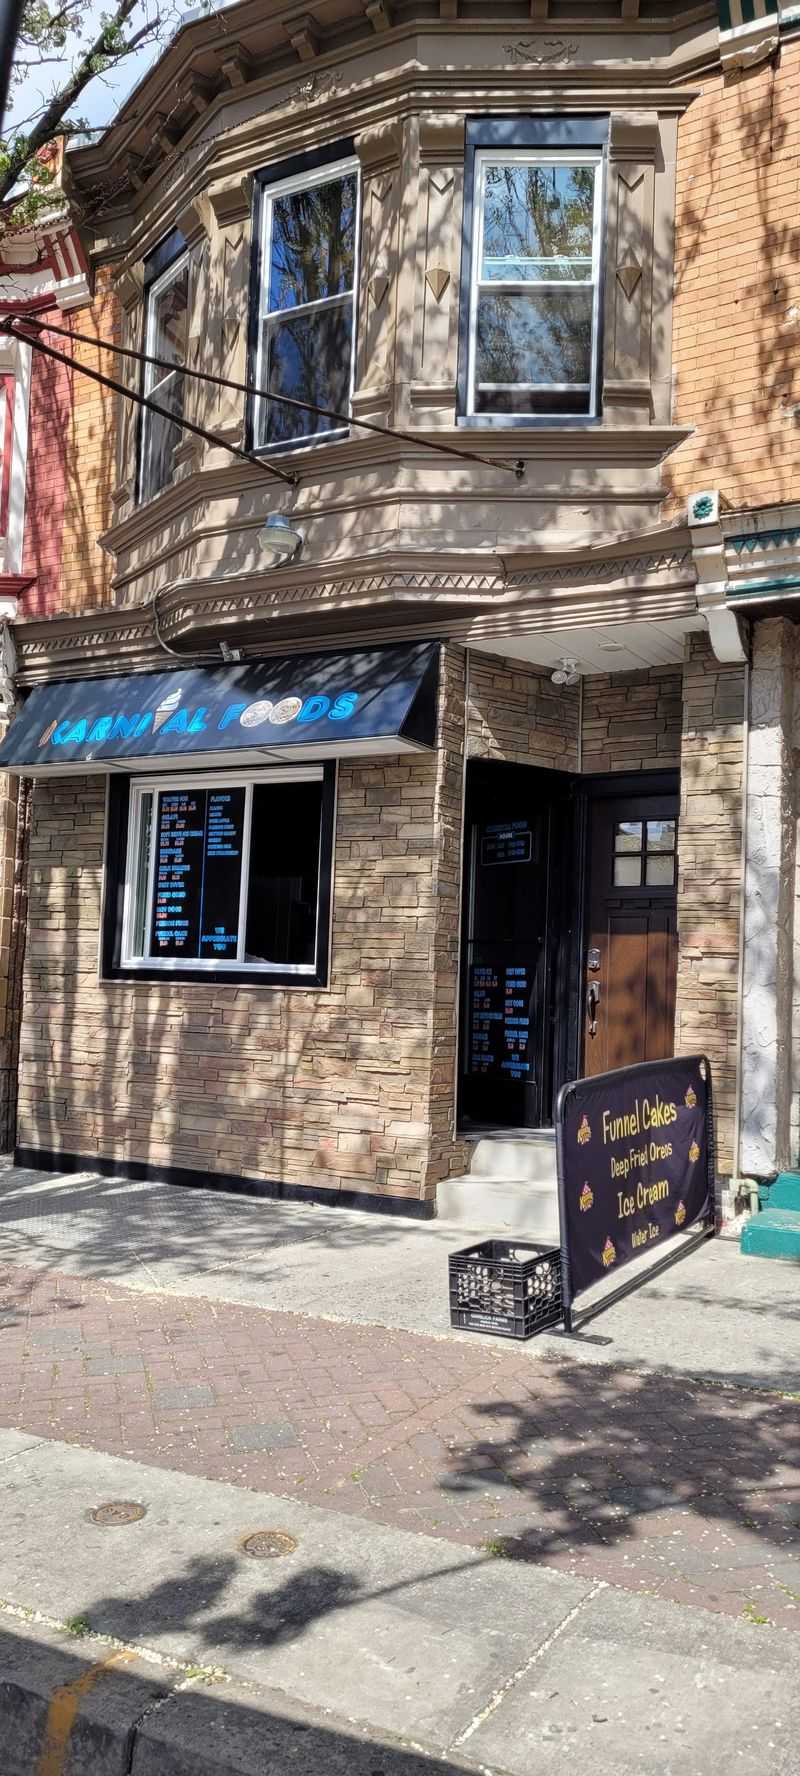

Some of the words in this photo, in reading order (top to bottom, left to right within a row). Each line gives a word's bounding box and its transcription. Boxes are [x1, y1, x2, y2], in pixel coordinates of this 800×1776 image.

[217, 691, 359, 730] FOODS
[602, 1098, 640, 1145] Funnel
[642, 1093, 677, 1130] Cakes
[611, 1156, 630, 1179] Deep
[629, 1143, 648, 1169] Fried
[649, 1141, 673, 1162] Oreos
[617, 1192, 635, 1219] Ice
[636, 1180, 669, 1209] Cream
[648, 1222, 660, 1239] Ice
